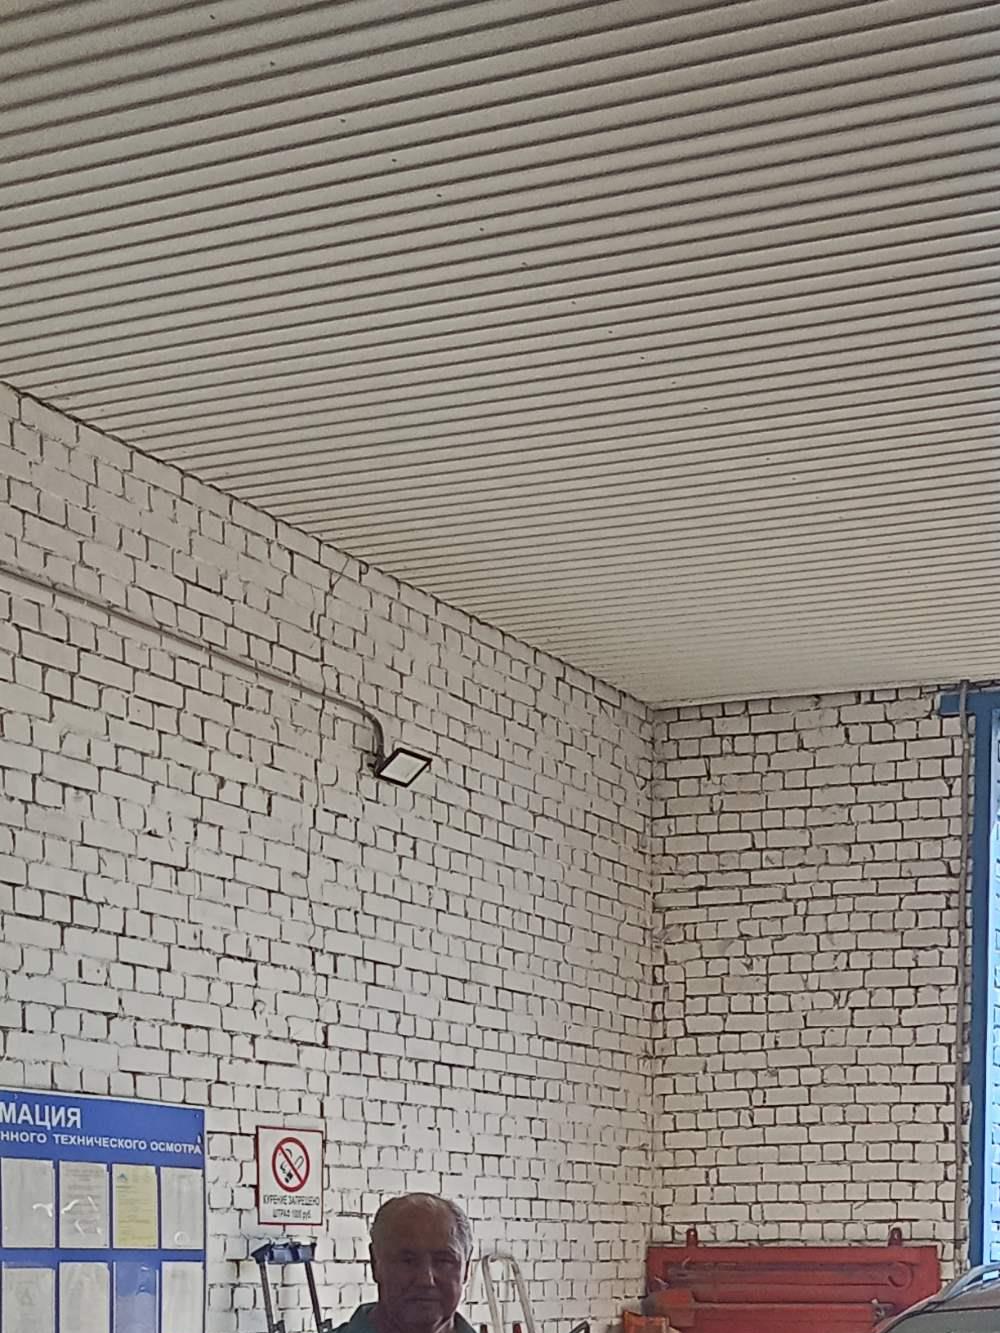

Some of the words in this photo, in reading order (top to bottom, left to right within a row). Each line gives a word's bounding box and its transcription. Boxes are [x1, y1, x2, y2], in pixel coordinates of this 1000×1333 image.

[0, 1101, 81, 1130] МАЦИЯ
[53, 1134, 147, 1151] ТЕХНИЧЕСКОГО
[150, 1141, 202, 1155] ОСМОТРА
